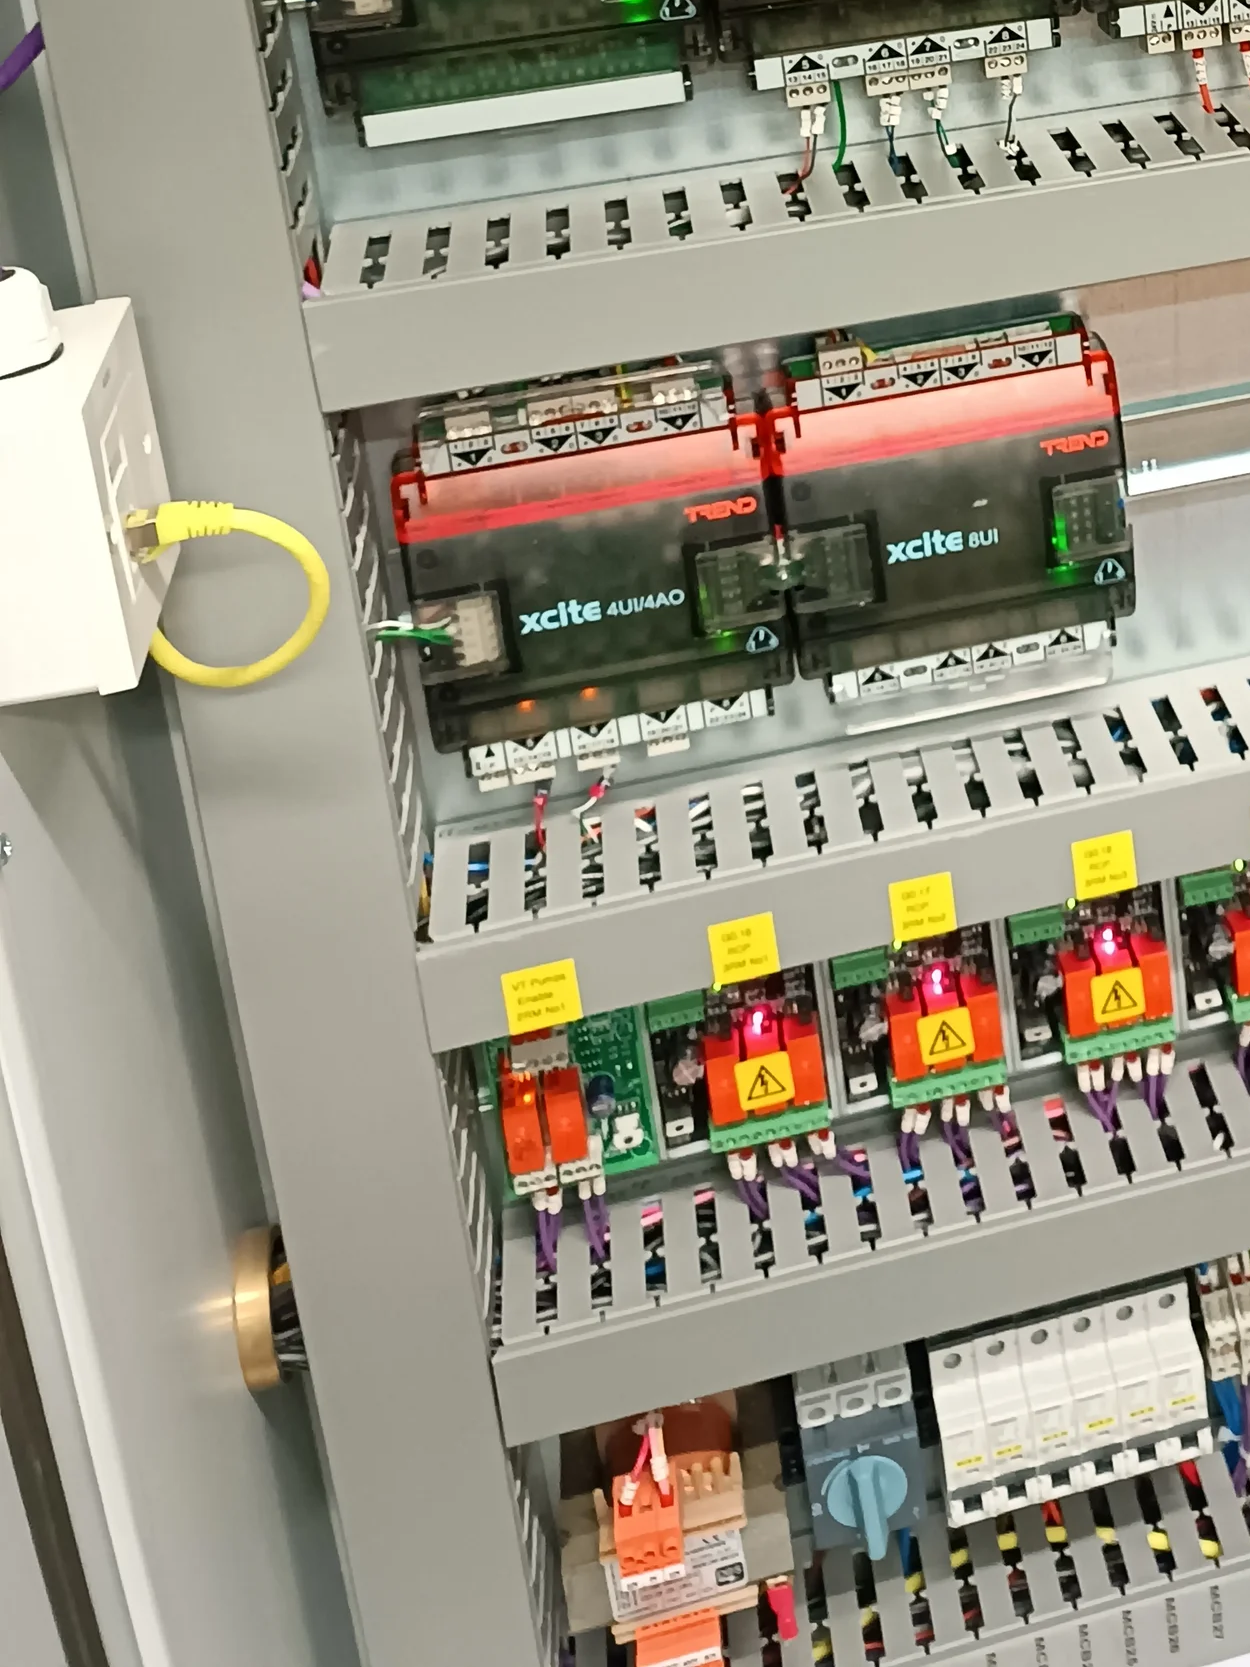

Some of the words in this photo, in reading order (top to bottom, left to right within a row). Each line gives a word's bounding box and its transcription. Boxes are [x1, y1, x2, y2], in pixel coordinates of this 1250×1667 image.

[1040, 430, 1108, 456] TREND
[683, 496, 757, 523] TREND
[886, 529, 963, 565] xcite
[969, 528, 998, 549] 8UI
[519, 599, 602, 635] xcite
